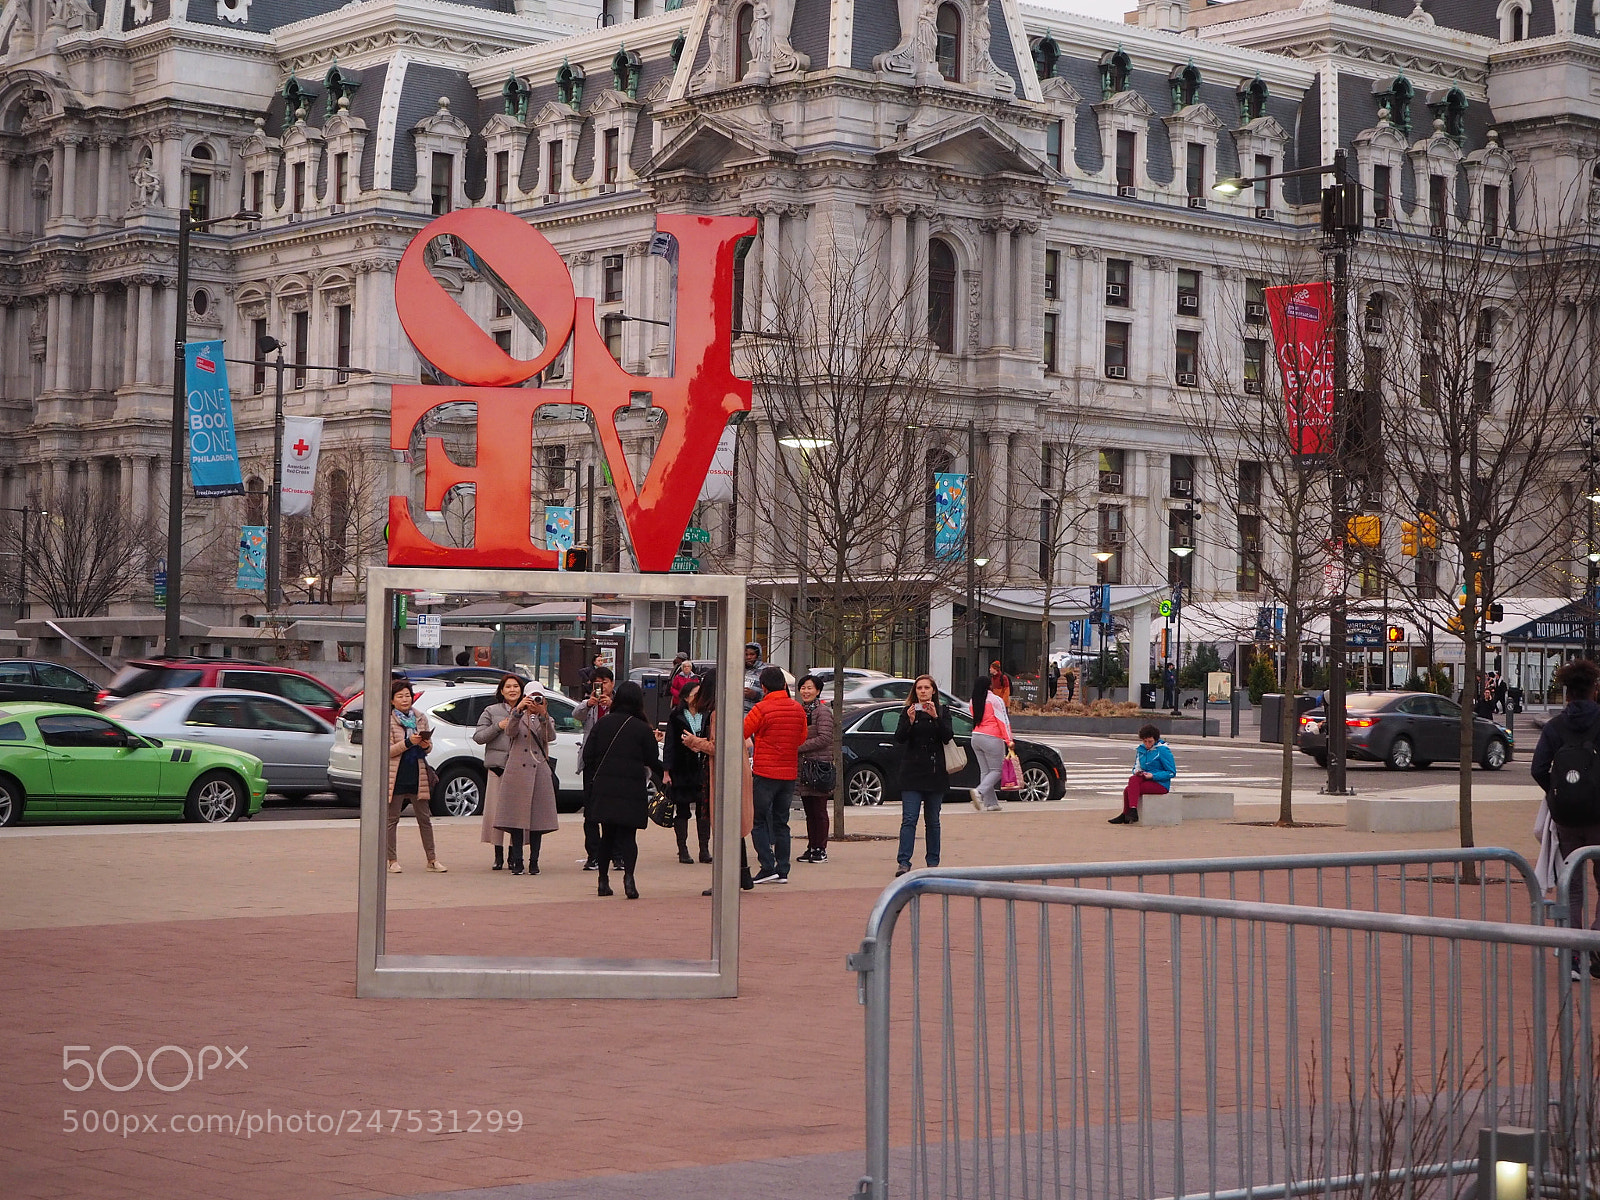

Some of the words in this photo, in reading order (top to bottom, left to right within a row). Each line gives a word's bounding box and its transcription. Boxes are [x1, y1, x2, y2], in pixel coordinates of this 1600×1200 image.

[187, 388, 226, 412] ONE
[190, 412, 228, 430] BOOK
[191, 430, 232, 454] ONE
[708, 469, 733, 477] ross.org
[1536, 622, 1570, 638] ROTHMAN
